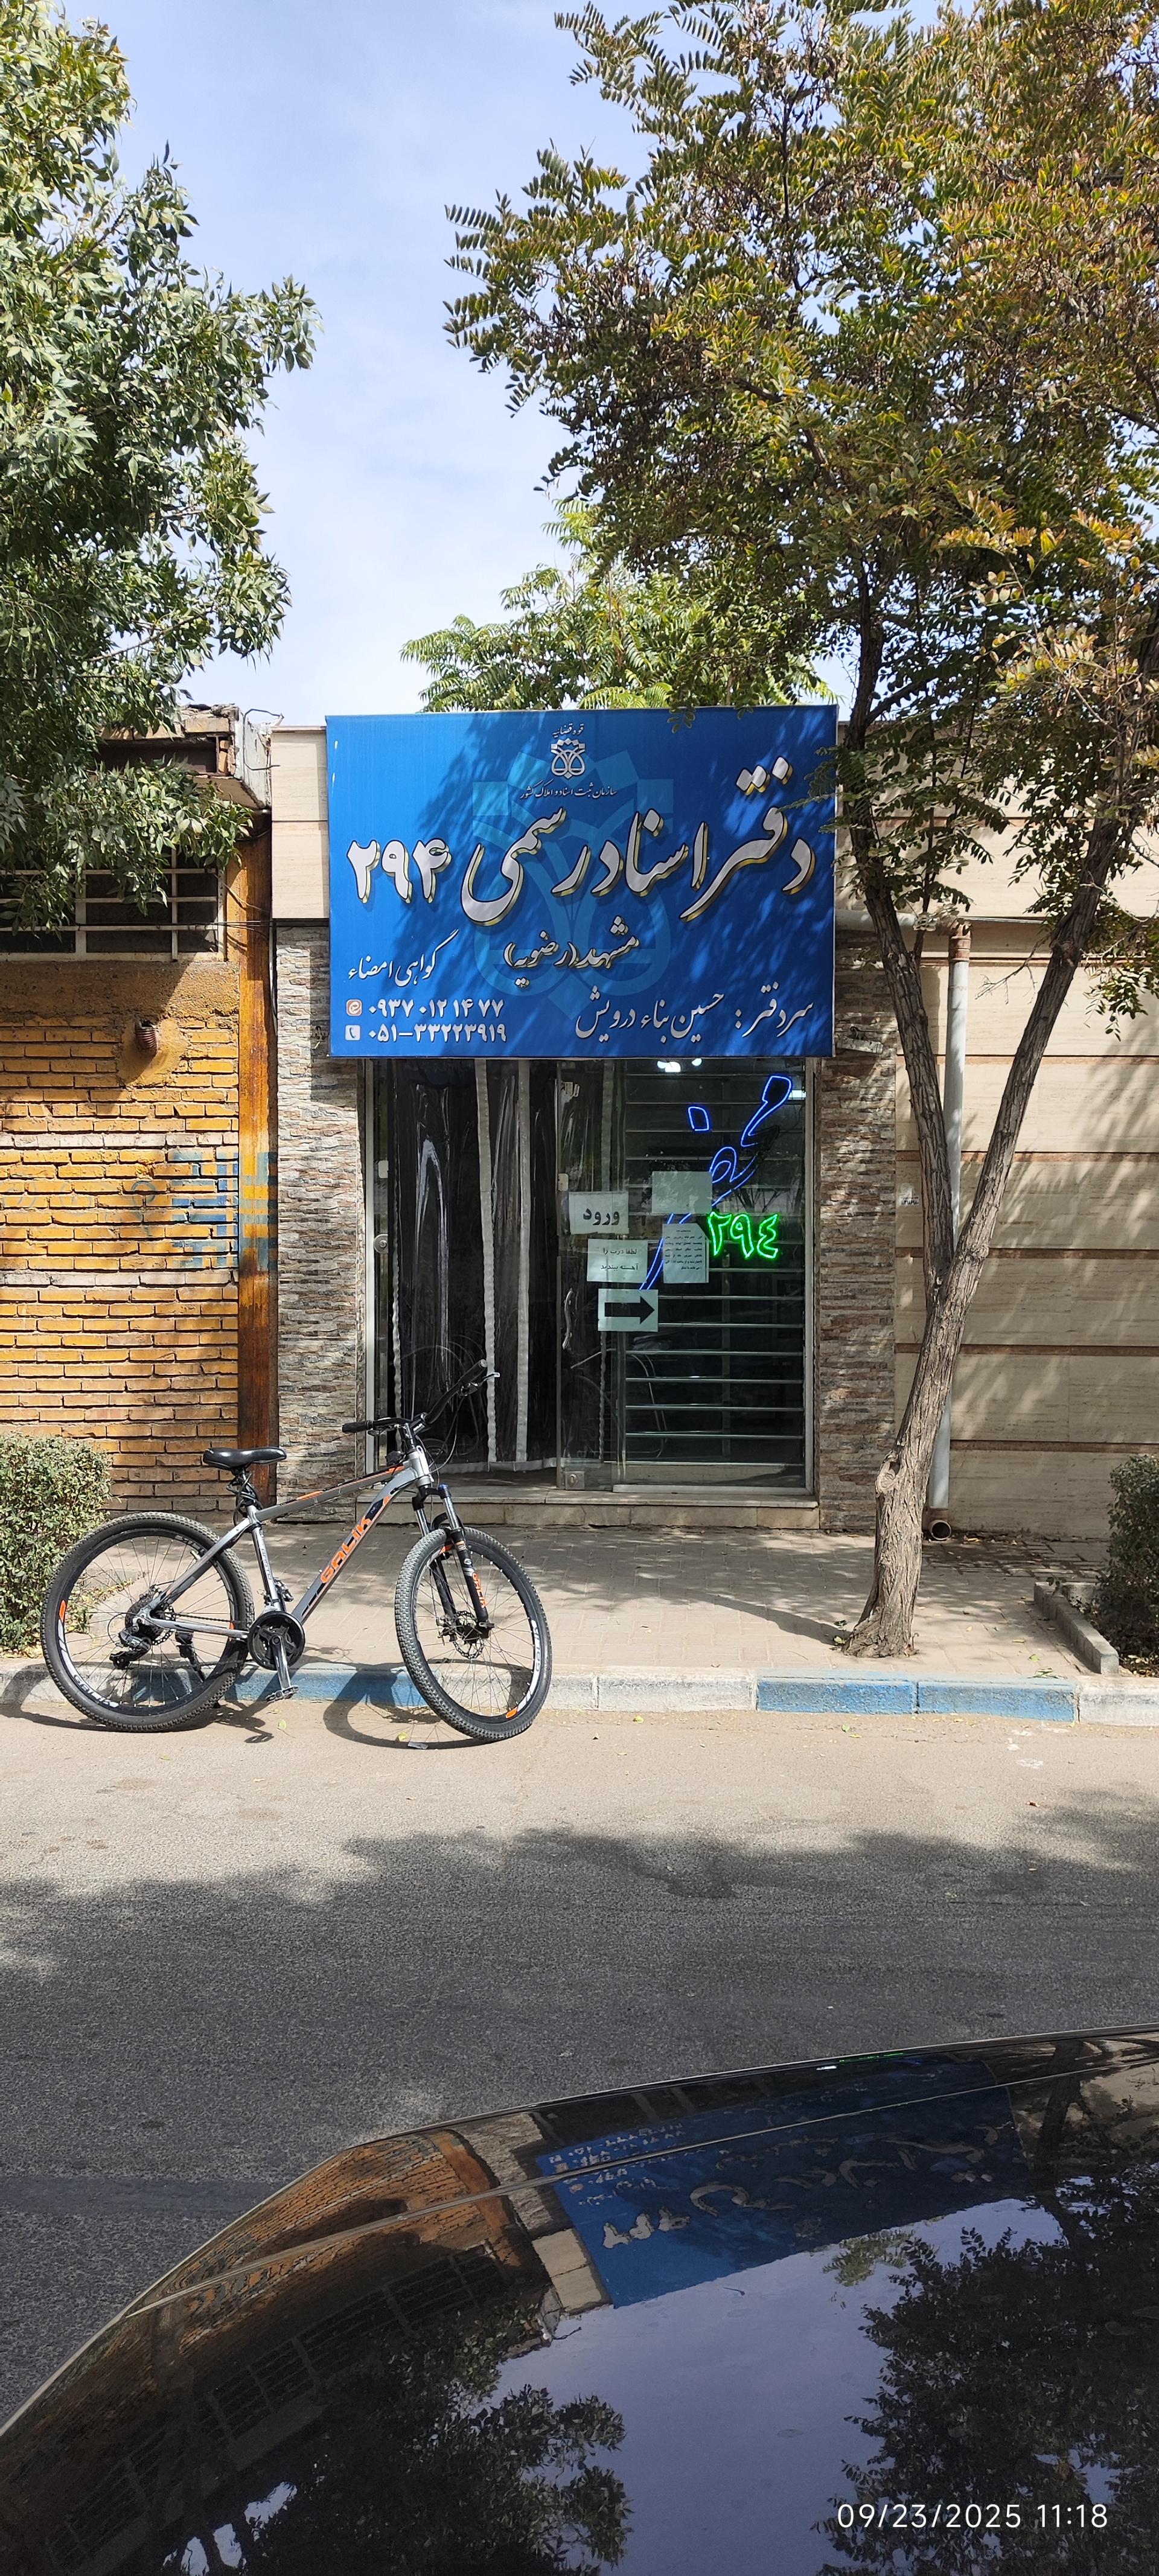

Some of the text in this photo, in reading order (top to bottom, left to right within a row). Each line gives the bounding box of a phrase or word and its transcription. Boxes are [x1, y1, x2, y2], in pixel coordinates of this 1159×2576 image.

[573, 723, 585, 736] قوه
[519, 779, 544, 799] کشور
[535, 778, 554, 797] املاک
[559, 786, 573, 797] اسناد
[575, 782, 593, 798] ثبت
[592, 786, 618, 799] سازمان
[346, 756, 816, 926] دفتر اسناد رسمی ۲۹۴
[574, 914, 640, 969] مشهد
[347, 929, 459, 987] گواهی امضاء
[575, 984, 636, 1043] درویش
[671, 992, 725, 1043] حسین
[583, 1208, 620, 1226] ورود
[603, 1247, 608, 1255] را
